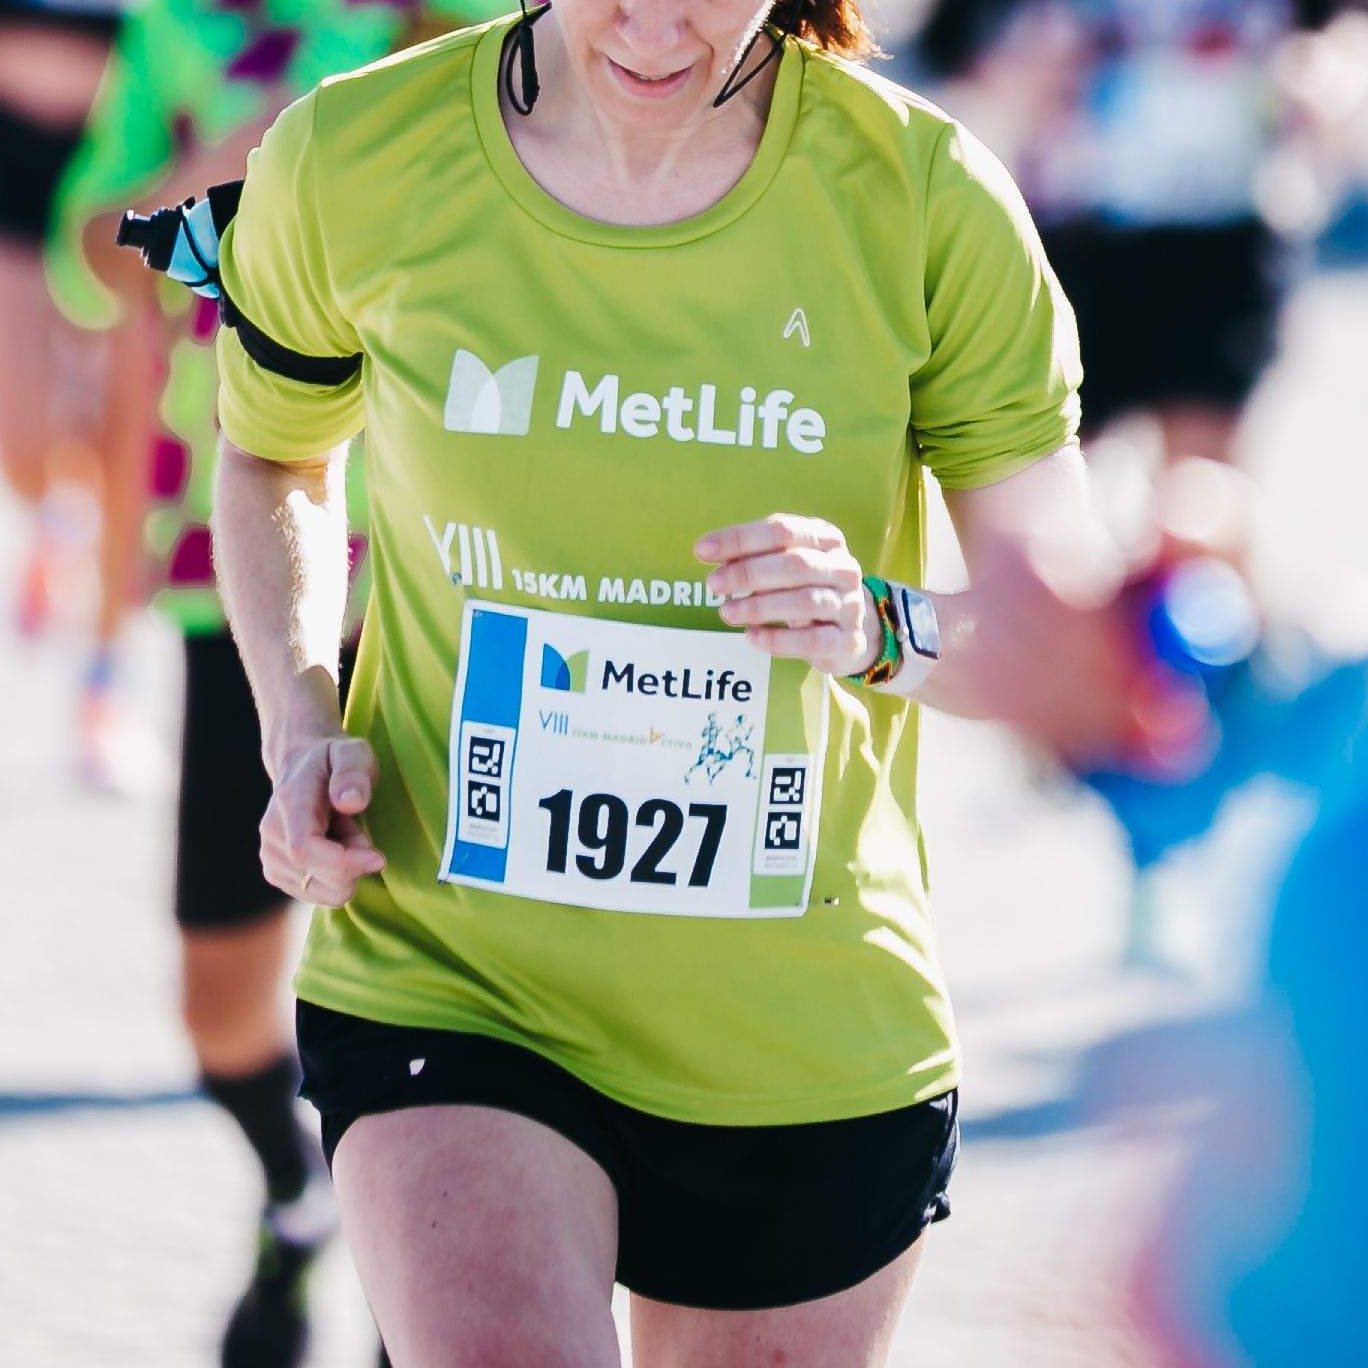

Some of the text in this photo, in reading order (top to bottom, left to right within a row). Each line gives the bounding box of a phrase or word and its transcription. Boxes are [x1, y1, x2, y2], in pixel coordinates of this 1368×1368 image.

[555, 369, 827, 455] MetLife
[422, 514, 503, 591] VIII
[512, 568, 587, 601] 15KM
[538, 710, 570, 736] VIII
[601, 660, 753, 702] MetLife
[538, 788, 728, 888] 1927
